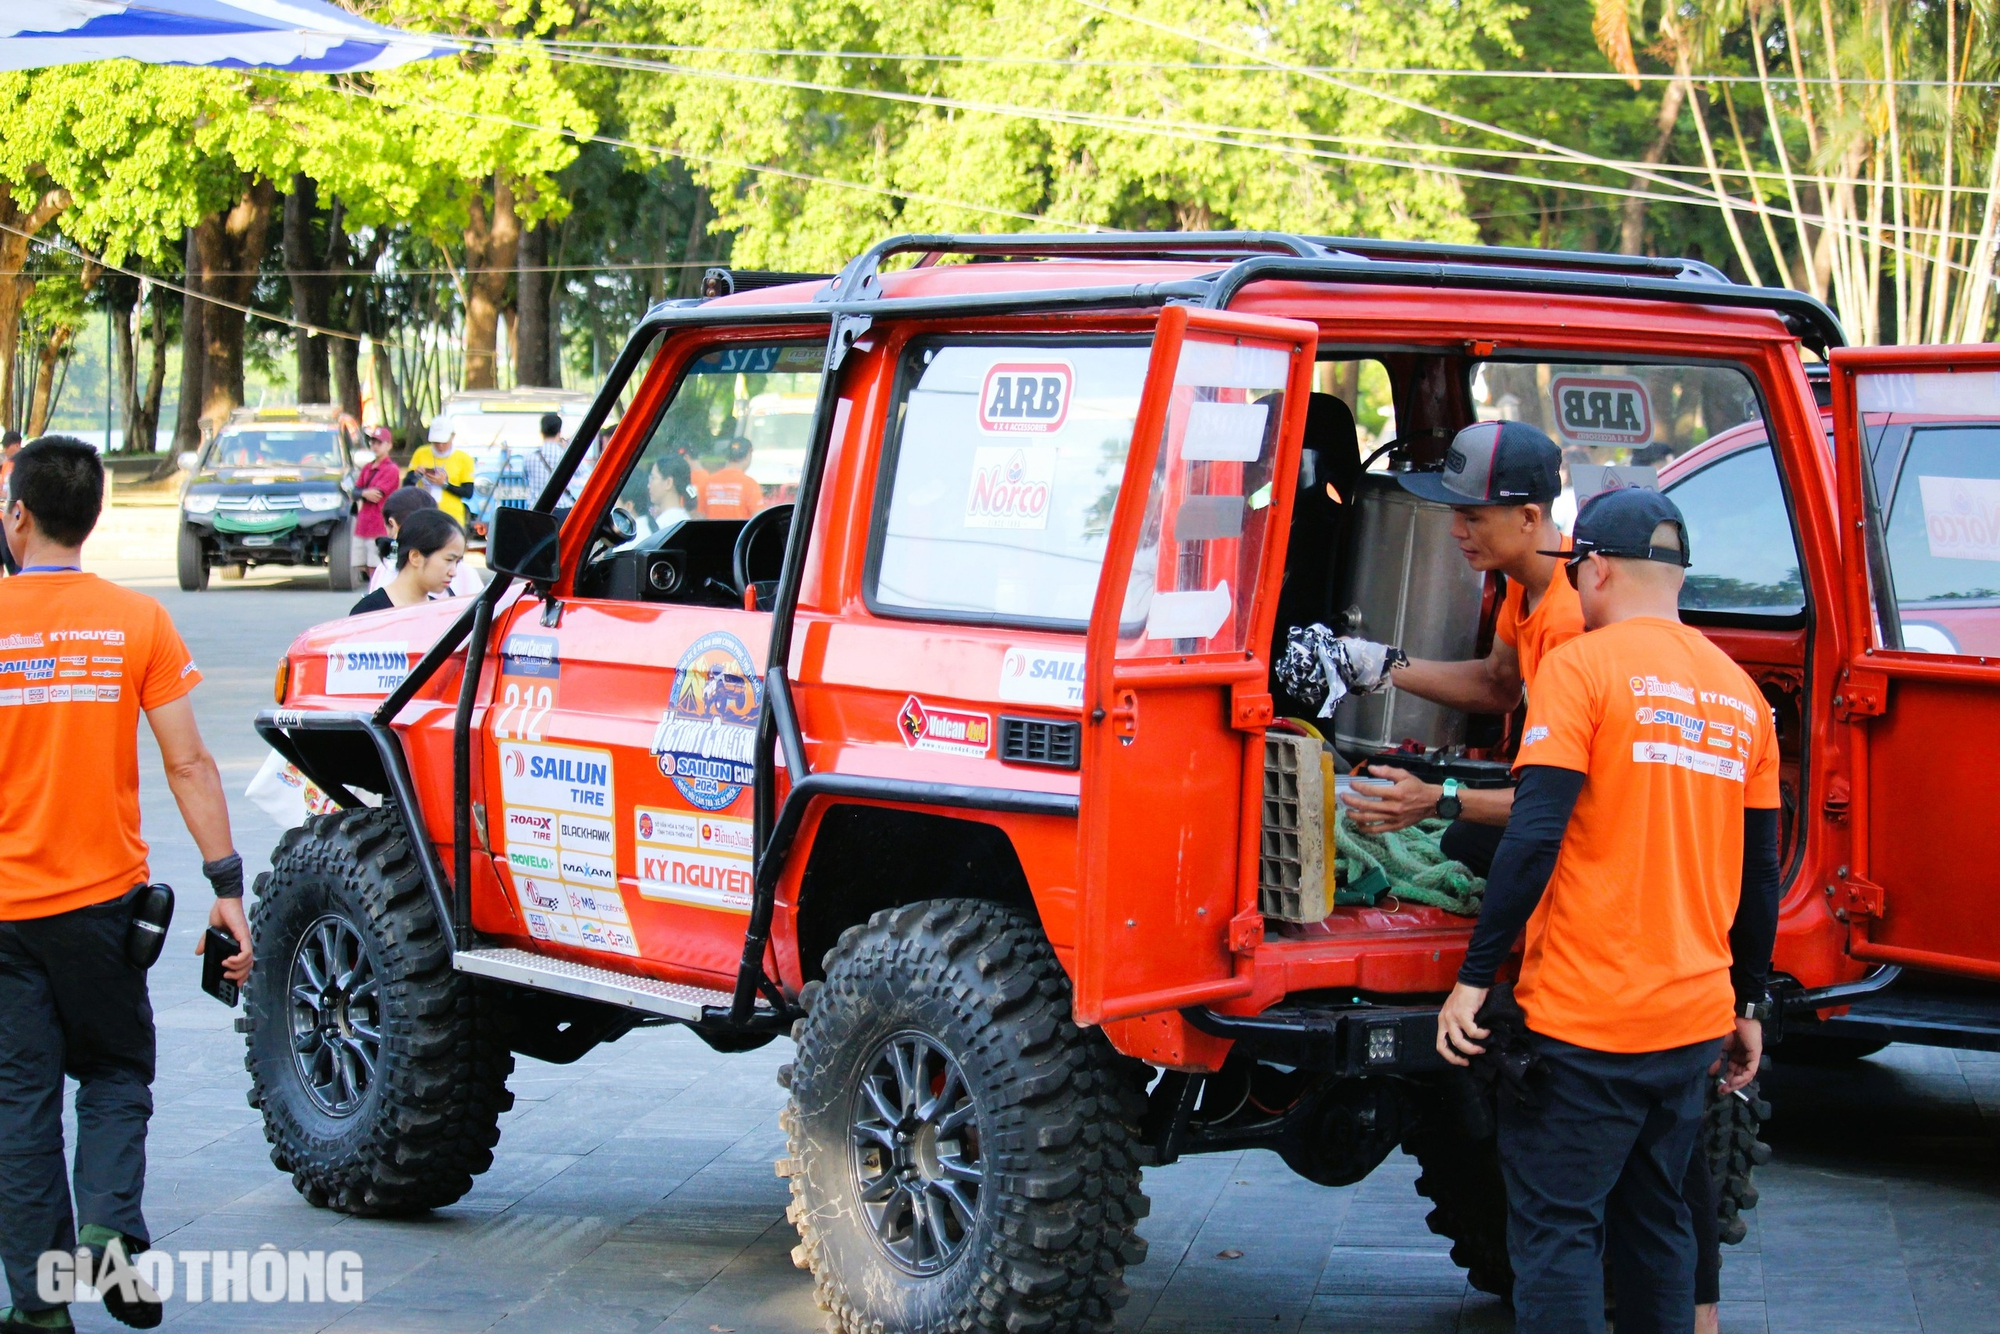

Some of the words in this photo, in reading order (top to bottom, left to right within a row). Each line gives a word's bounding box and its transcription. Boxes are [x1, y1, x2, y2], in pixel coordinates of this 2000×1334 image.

[988, 377, 1062, 418] ARB
[994, 423, 998, 431] 4
[1004, 423, 1010, 431] 4
[1010, 423, 1048, 432] ACCESSORIES
[970, 466, 1048, 514] Norco
[348, 651, 406, 670] SAILUN
[25, 671, 54, 680] TIRE
[1029, 659, 1085, 682] SAILU
[378, 675, 404, 688] TIRE
[495, 683, 553, 742] 212
[1654, 710, 1704, 732] SAILUN
[929, 716, 966, 740] Vulcan
[966, 720, 986, 743] 4x4
[1682, 730, 1700, 742] TIRE
[922, 742, 984, 756] www.vulcan4x4.com
[530, 756, 606, 786] SAILUN
[676, 757, 732, 782] SAILUN
[695, 778, 718, 794] 2024
[570, 788, 604, 806] TIRE
[510, 814, 552, 830] ROADX
[532, 831, 551, 841] TIRE
[562, 824, 610, 842] BLACKHAWK
[510, 853, 549, 870] ROVELO
[563, 862, 612, 878] MAXAM
[580, 896, 596, 910] MB
[582, 932, 608, 944] POPA
[616, 934, 633, 945] PVI
